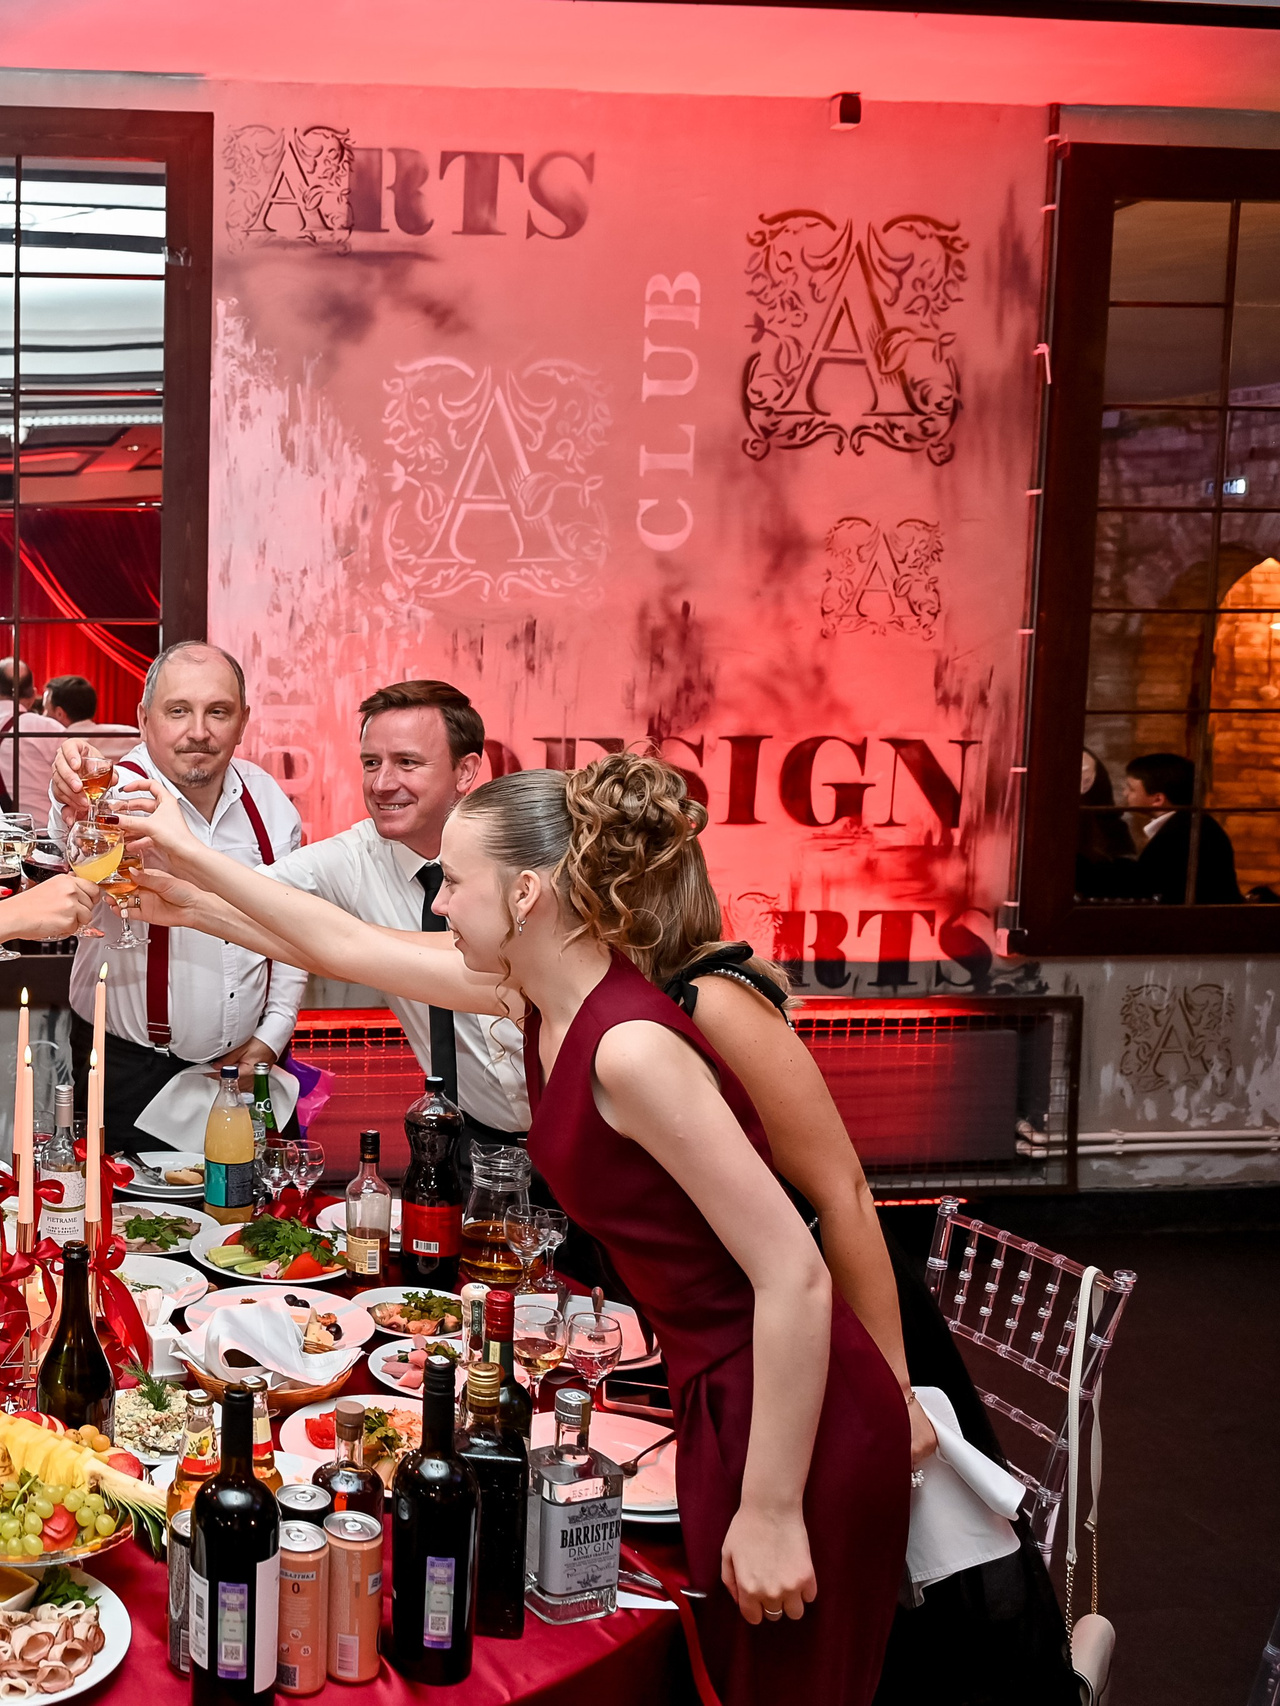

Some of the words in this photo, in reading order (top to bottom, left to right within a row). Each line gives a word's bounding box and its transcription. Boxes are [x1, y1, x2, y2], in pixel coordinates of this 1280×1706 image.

[242, 137, 596, 240] ARTS
[636, 270, 702, 552] CLUB
[0, 1321, 40, 1384] 4
[560, 1519, 621, 1549] BARRISTER
[569, 1545, 591, 1558] DRY
[593, 1541, 615, 1553] GIN
[292, 1582, 300, 1594] 0
